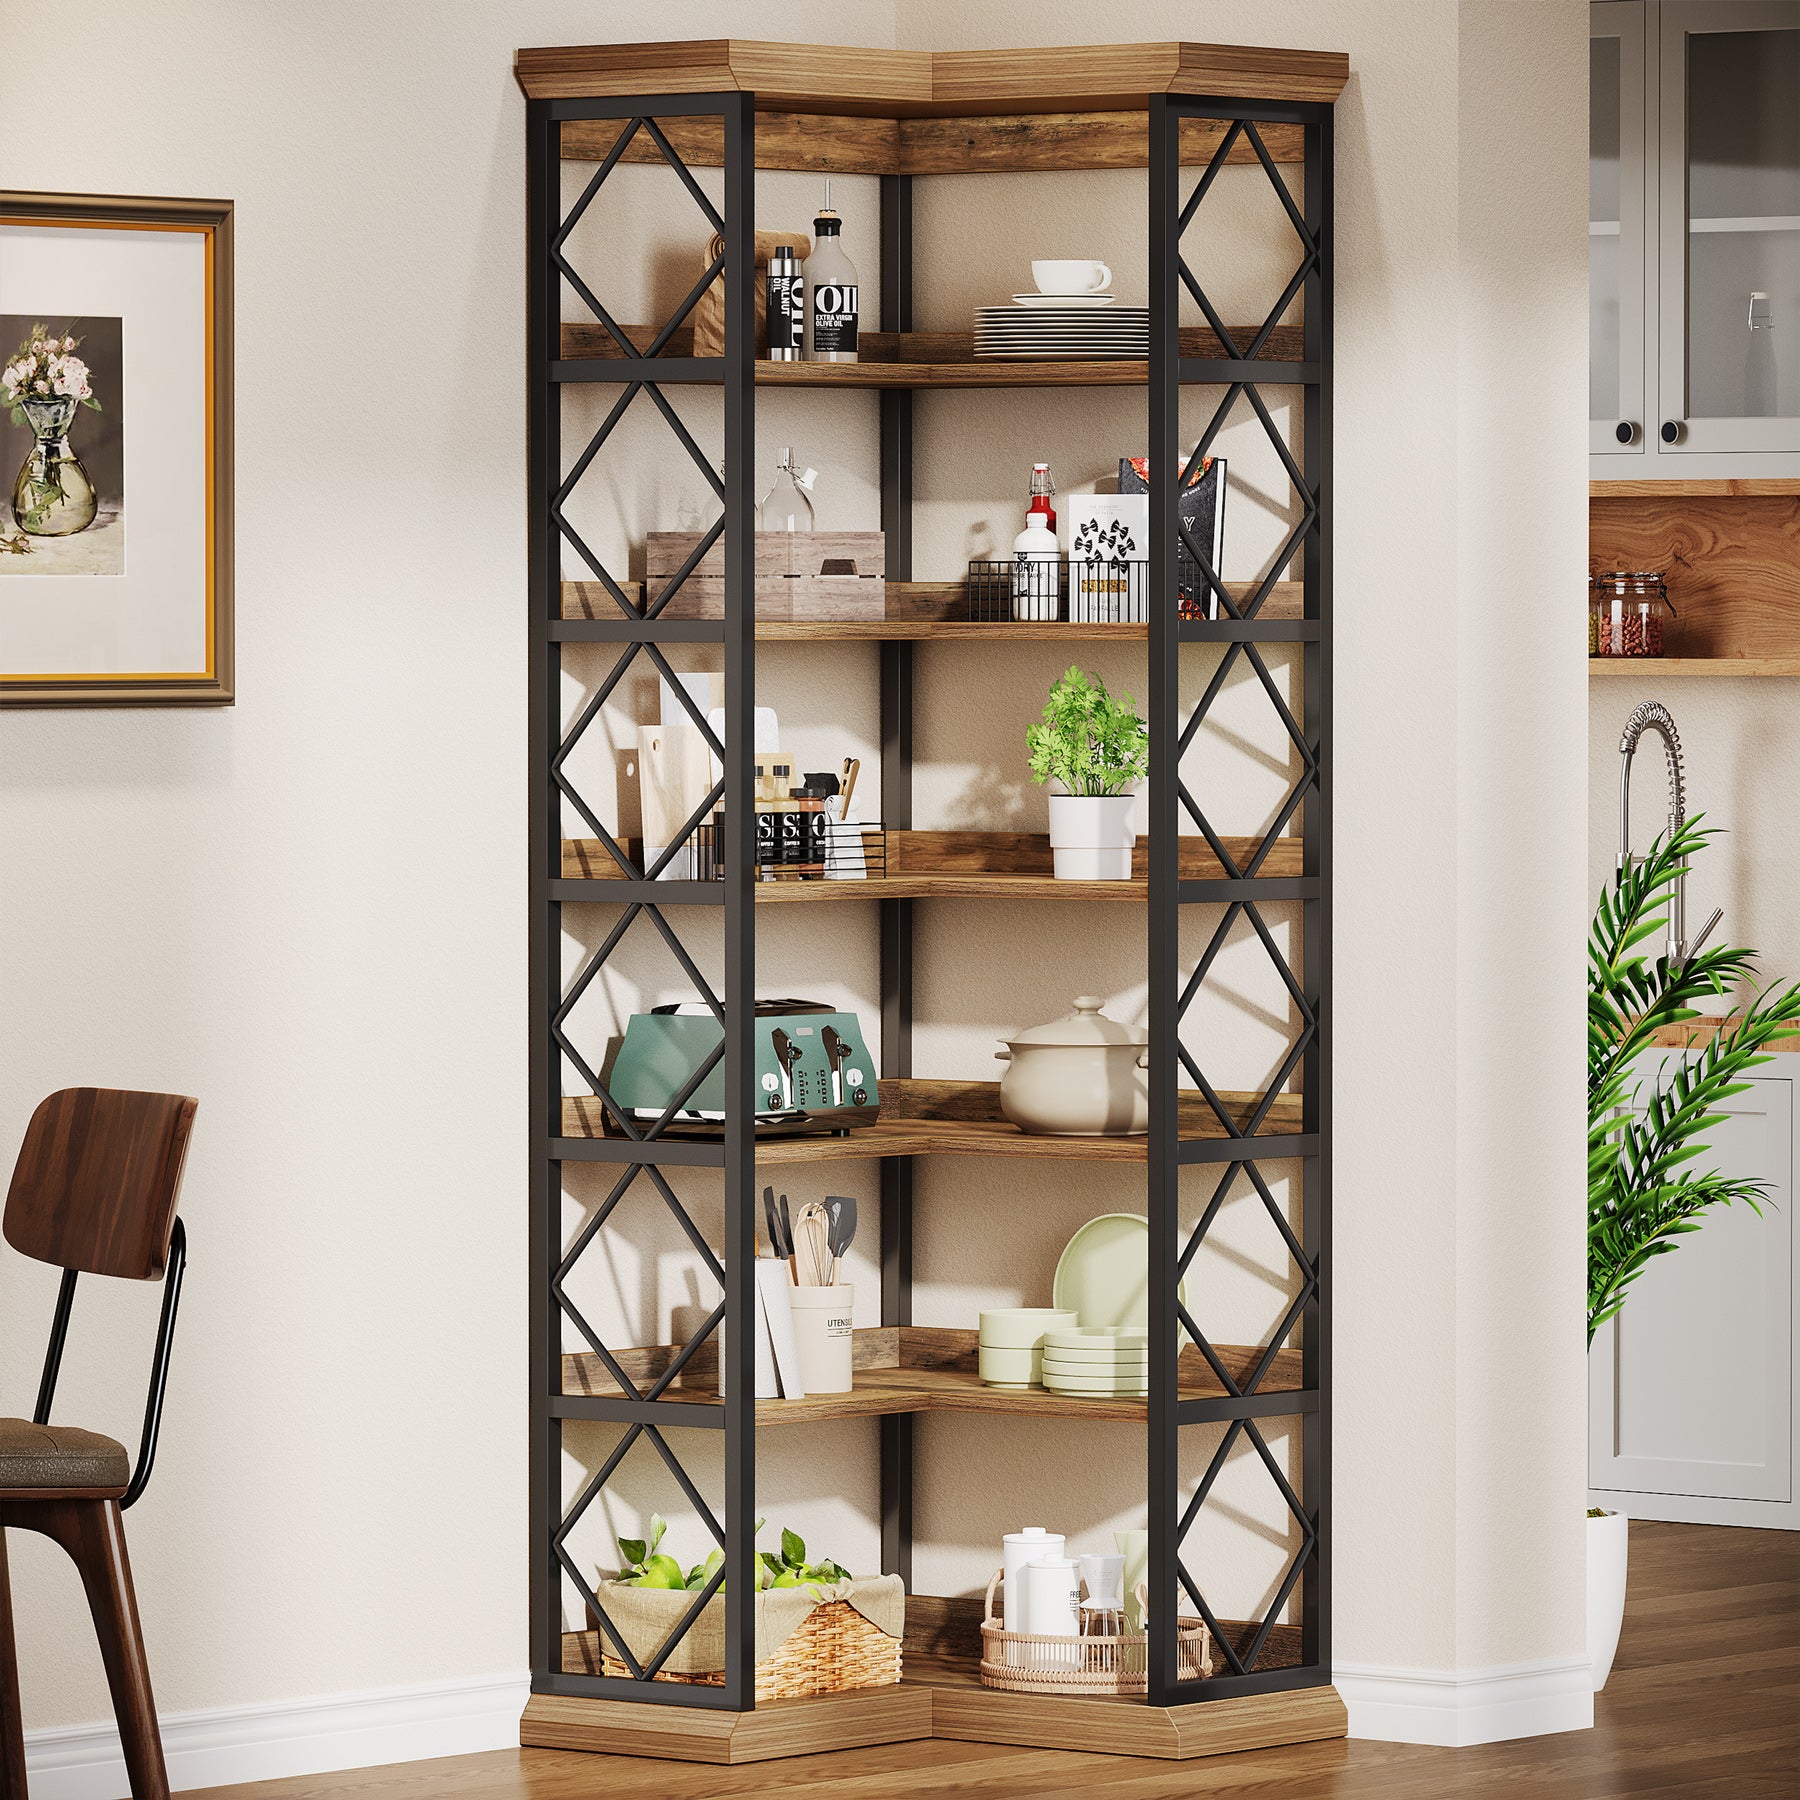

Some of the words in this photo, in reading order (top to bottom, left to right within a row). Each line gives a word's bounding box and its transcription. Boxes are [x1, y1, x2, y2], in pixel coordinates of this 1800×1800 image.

[774, 277, 782, 293] OIL
[781, 277, 791, 317] WALNUT
[833, 320, 844, 328] OIL
